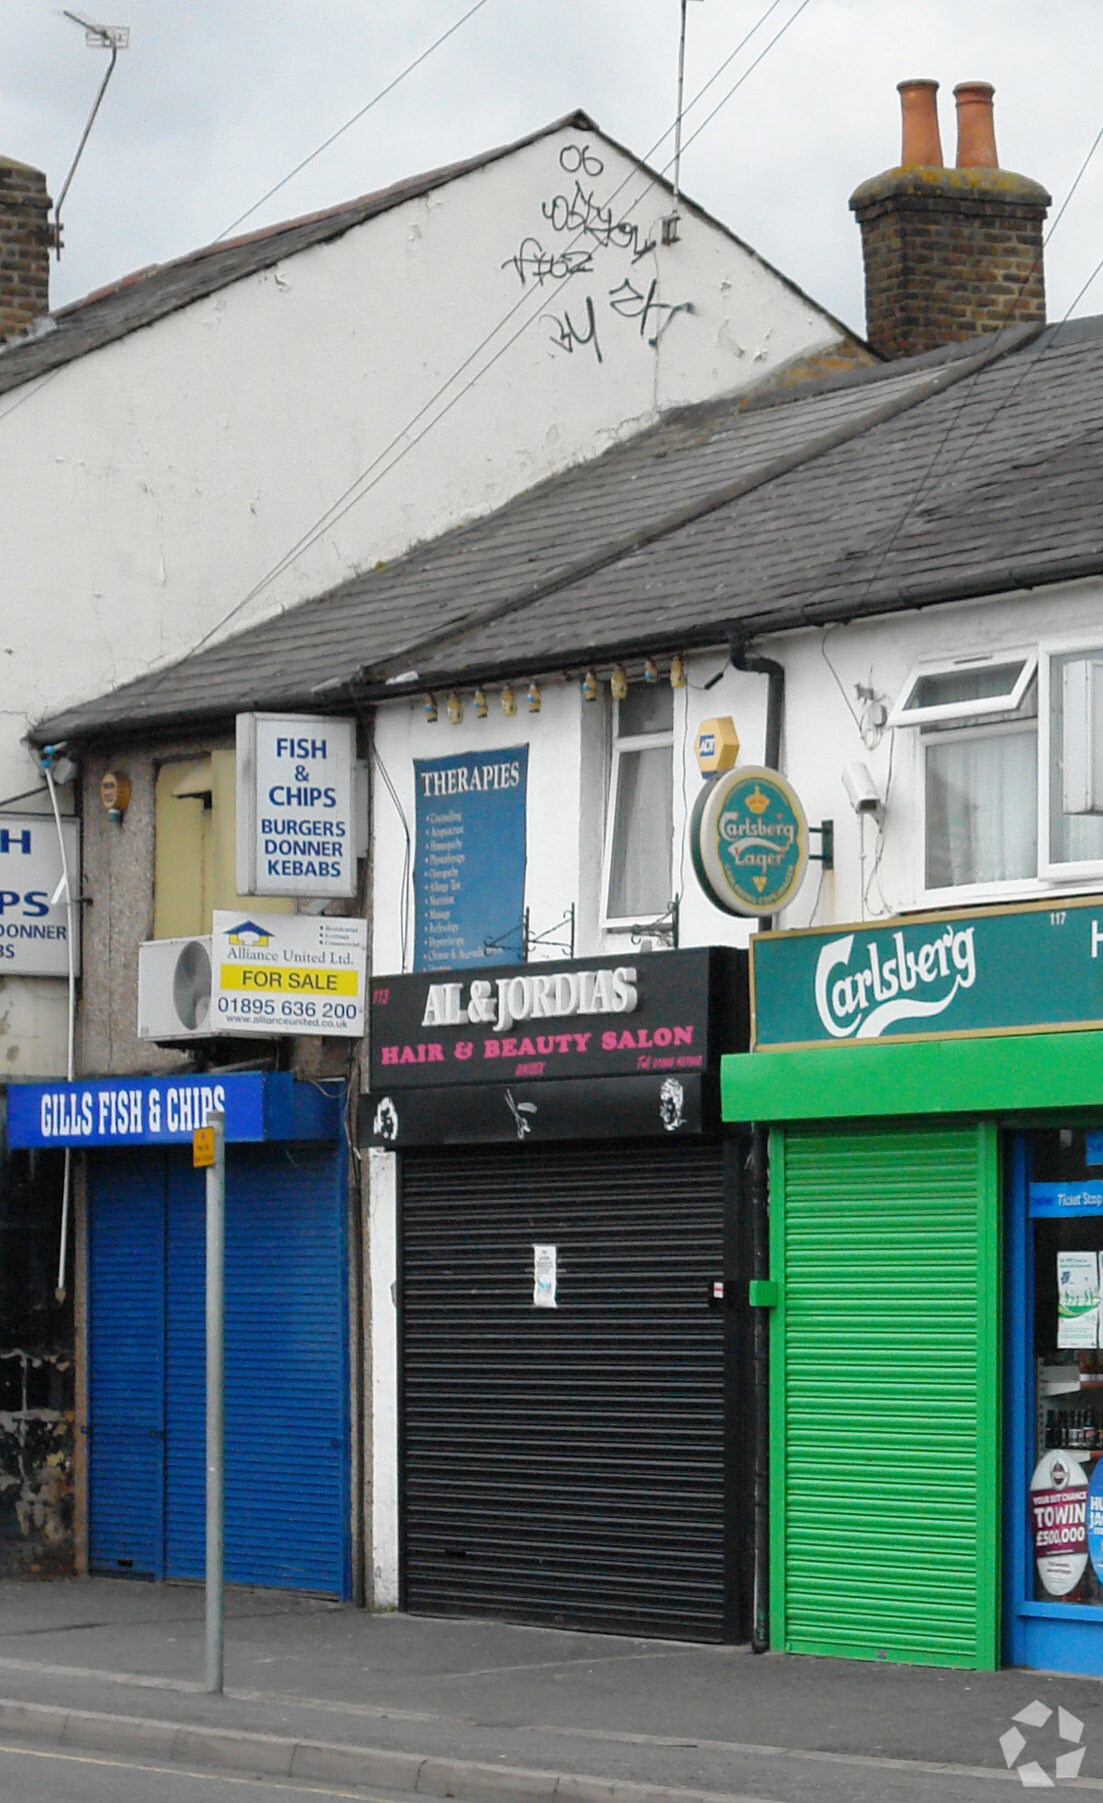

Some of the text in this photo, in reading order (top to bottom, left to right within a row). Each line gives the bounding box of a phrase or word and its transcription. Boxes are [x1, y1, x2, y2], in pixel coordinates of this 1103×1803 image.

[559, 144, 604, 176] 06
[276, 737, 327, 759] FISH
[294, 764, 310, 782] &
[421, 761, 520, 797] THERAPIES
[268, 785, 337, 808] CHIPS
[261, 818, 346, 838] BURGERS
[719, 811, 795, 843] Carlsberg
[264, 839, 343, 857] DONNER
[267, 859, 341, 877] KEBABS
[734, 853, 784, 877] Lager
[0, 890, 49, 917] PS
[1049, 911, 1067, 926] 117
[227, 947, 354, 966] Alliance United Ltd.
[242, 970, 338, 991] FOR SALE
[814, 924, 977, 1038] Carlsberg
[218, 997, 357, 1020] 01895 636 200
[226, 1015, 348, 1029] www.allianceunited.co.uk
[381, 1025, 695, 1066] HAIR & BEAUTY SALON
[41, 1084, 225, 1137] GILLS FISH & CHIPS
[1036, 1526, 1086, 1546] £500,000
